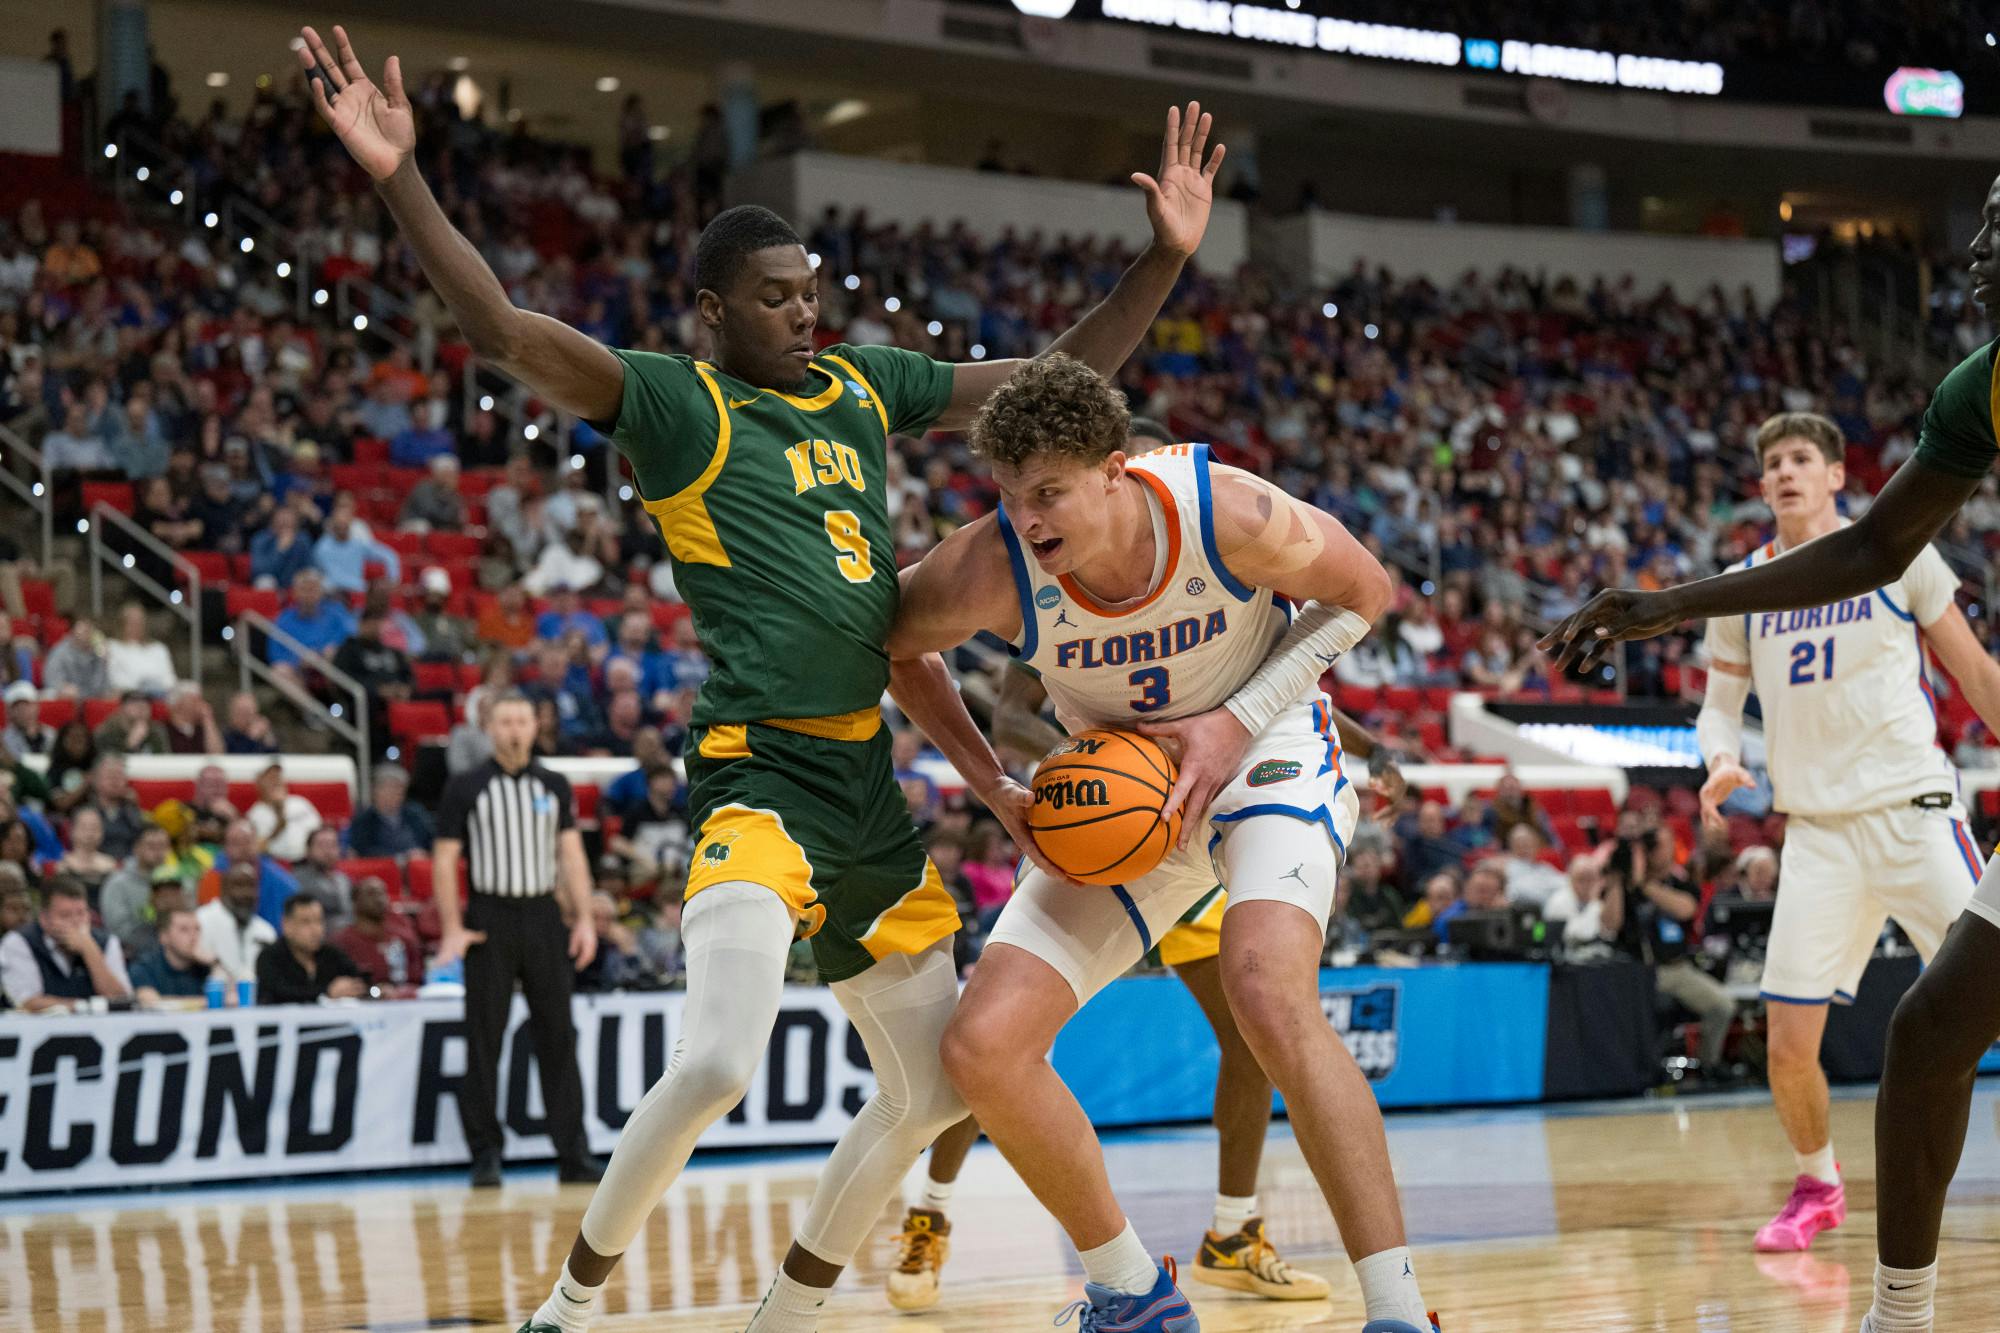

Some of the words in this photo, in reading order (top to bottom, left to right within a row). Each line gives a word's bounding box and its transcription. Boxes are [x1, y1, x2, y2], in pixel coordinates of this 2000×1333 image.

[784, 439, 866, 496] NSU
[824, 510, 876, 583] 9
[1055, 608, 1227, 668] FLORIDA
[1789, 637, 1835, 685] 21
[1128, 666, 1170, 712] 3
[1034, 779, 1109, 810] Wilso
[413, 1009, 875, 1144] ROUD
